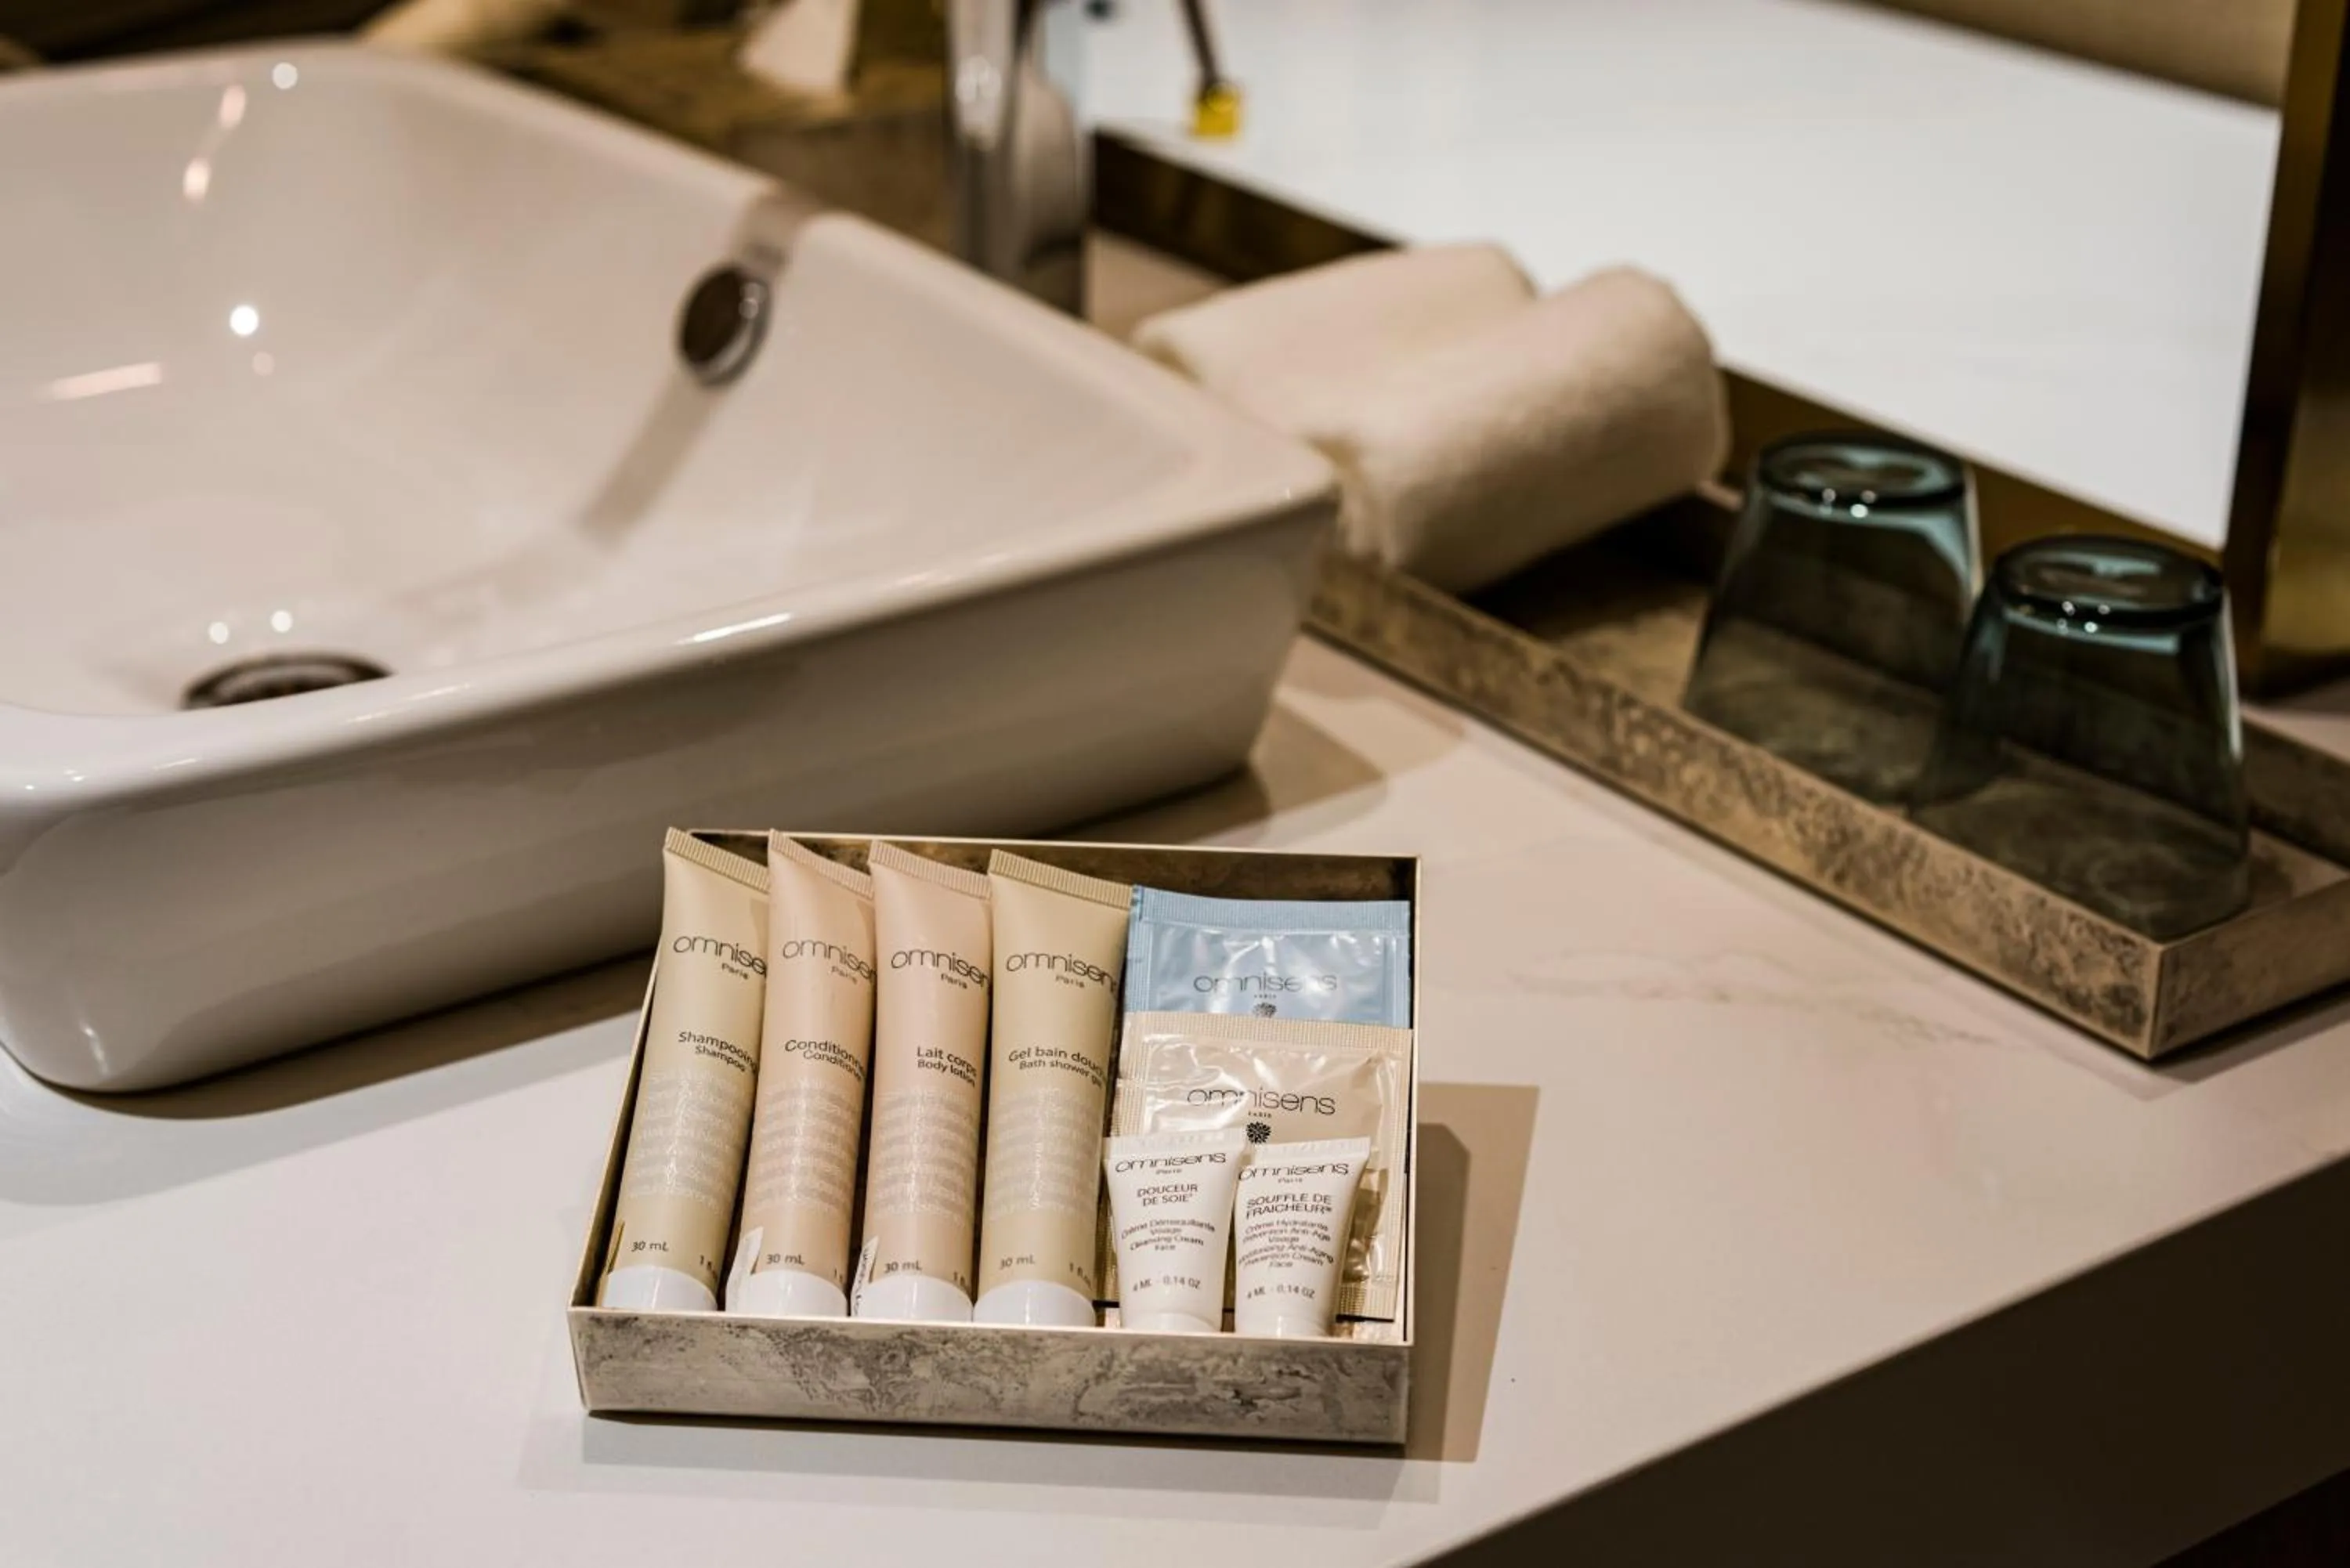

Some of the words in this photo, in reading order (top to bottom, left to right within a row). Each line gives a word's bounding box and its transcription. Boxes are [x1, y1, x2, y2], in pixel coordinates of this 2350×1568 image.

[721, 962, 749, 980] Paris
[831, 965, 857, 985] Paris
[941, 973, 967, 989] Paris
[1055, 974, 1084, 988] Paris
[916, 1046, 943, 1060] Lait
[946, 1053, 978, 1078] corps
[1008, 1047, 1031, 1063] Gel
[1036, 1046, 1067, 1058] bain
[917, 1059, 948, 1073] Body
[950, 1064, 977, 1088] lotion
[1019, 1059, 1046, 1070] Bath
[1050, 1059, 1090, 1077] shower
[1187, 1086, 1336, 1116] omnisens
[1115, 1152, 1227, 1173] omnisens
[1238, 1162, 1350, 1182] omnisens
[1137, 1183, 1198, 1198] DOUCEUR
[1143, 1196, 1159, 1207] DE
[1247, 1193, 1309, 1207] SOUFFLE
[1312, 1193, 1332, 1205] DE
[631, 1241, 646, 1252] 30
[649, 1241, 669, 1252] mL
[1130, 1235, 1173, 1252] Cleansing
[1174, 1235, 1204, 1247] Cream
[766, 1253, 781, 1264] 30
[784, 1253, 805, 1265] mL
[884, 1260, 899, 1273] 30
[902, 1259, 923, 1271] mL
[1000, 1257, 1014, 1270] 30
[1016, 1254, 1036, 1266] mL
